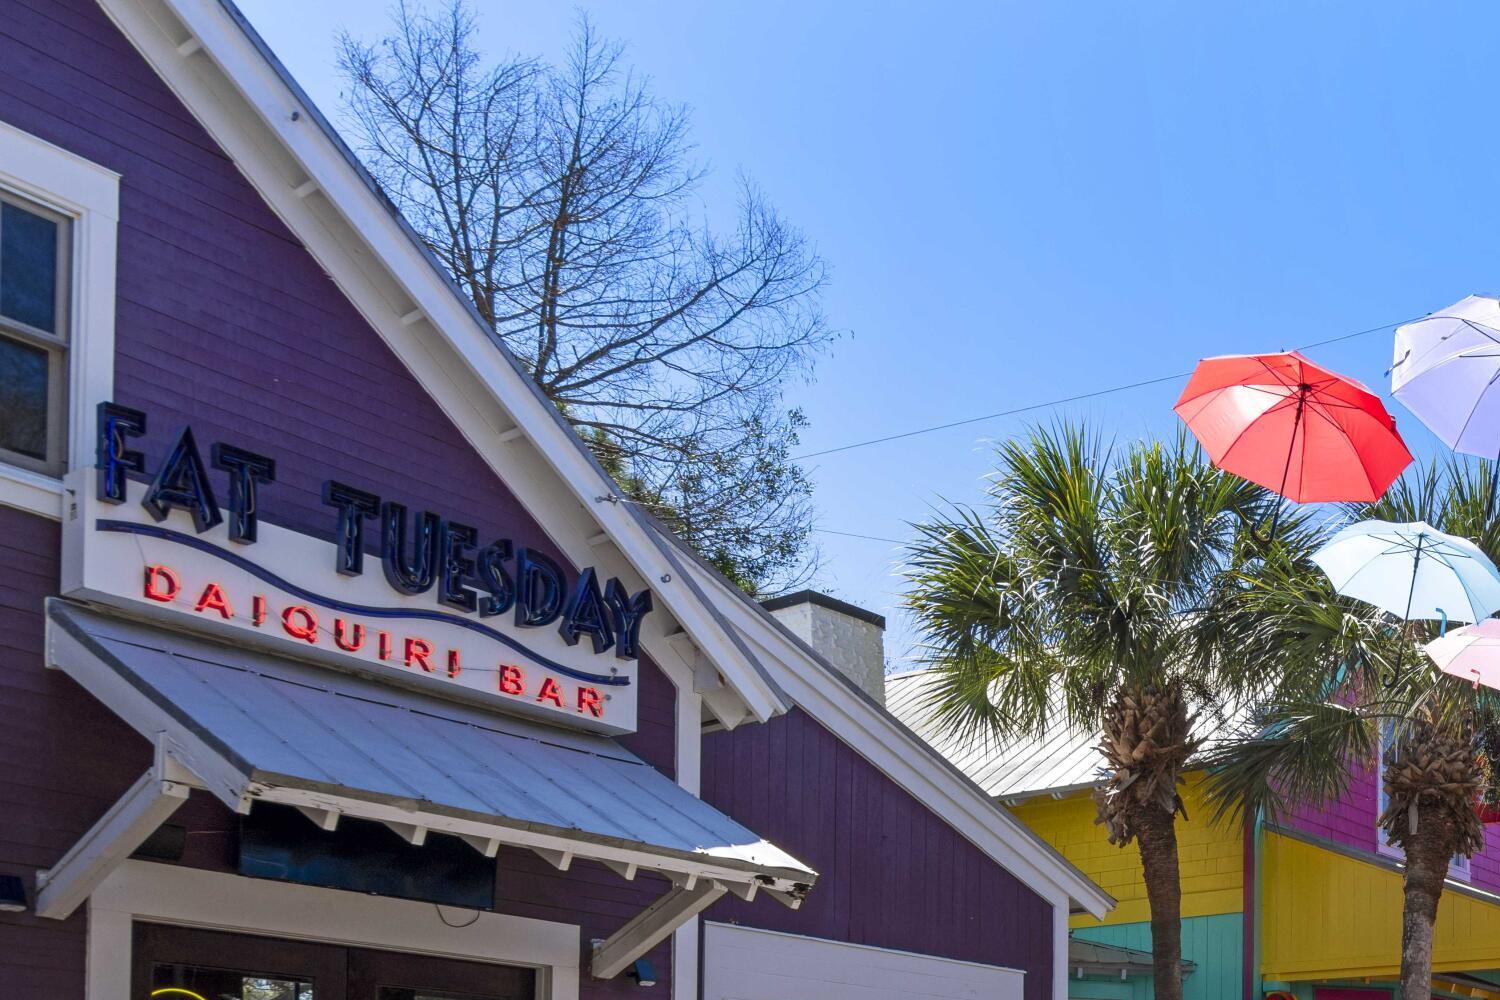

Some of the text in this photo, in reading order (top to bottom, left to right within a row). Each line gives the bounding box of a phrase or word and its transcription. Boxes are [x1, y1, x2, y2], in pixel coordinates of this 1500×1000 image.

[96, 401, 653, 662] FAT TUESDAY
[144, 565, 604, 718] DAIQUIRI BAR
